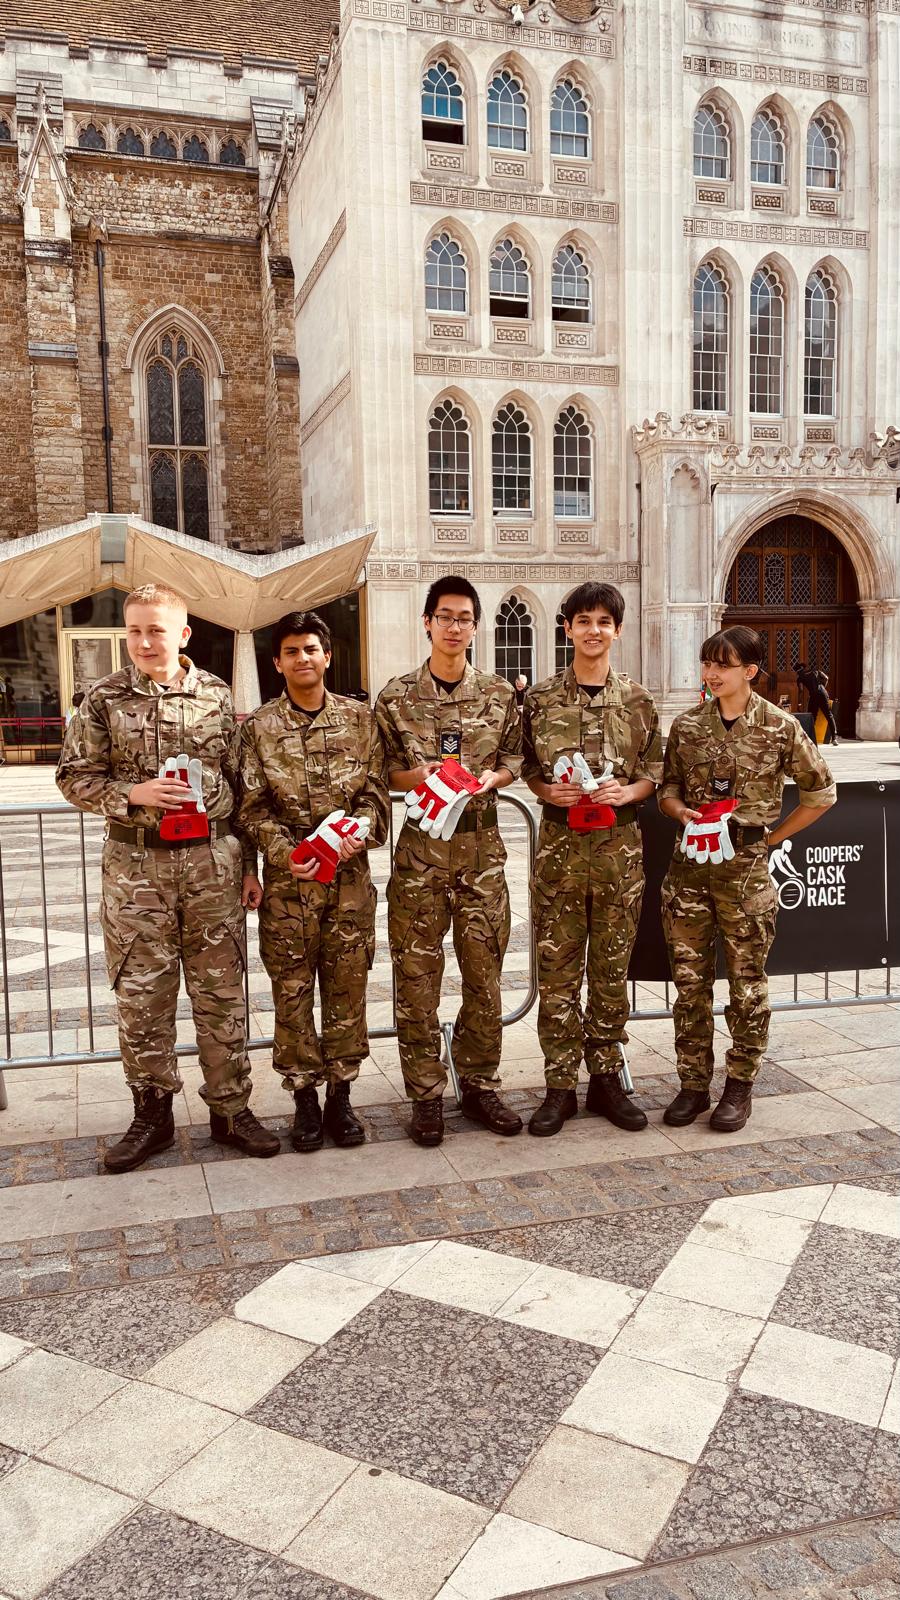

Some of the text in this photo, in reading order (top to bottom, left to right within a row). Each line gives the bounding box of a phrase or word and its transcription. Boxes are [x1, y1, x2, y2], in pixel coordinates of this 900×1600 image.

[690, 15, 753, 38] DOMINE
[807, 865, 846, 886] CASK
[807, 886, 846, 907] RACE
